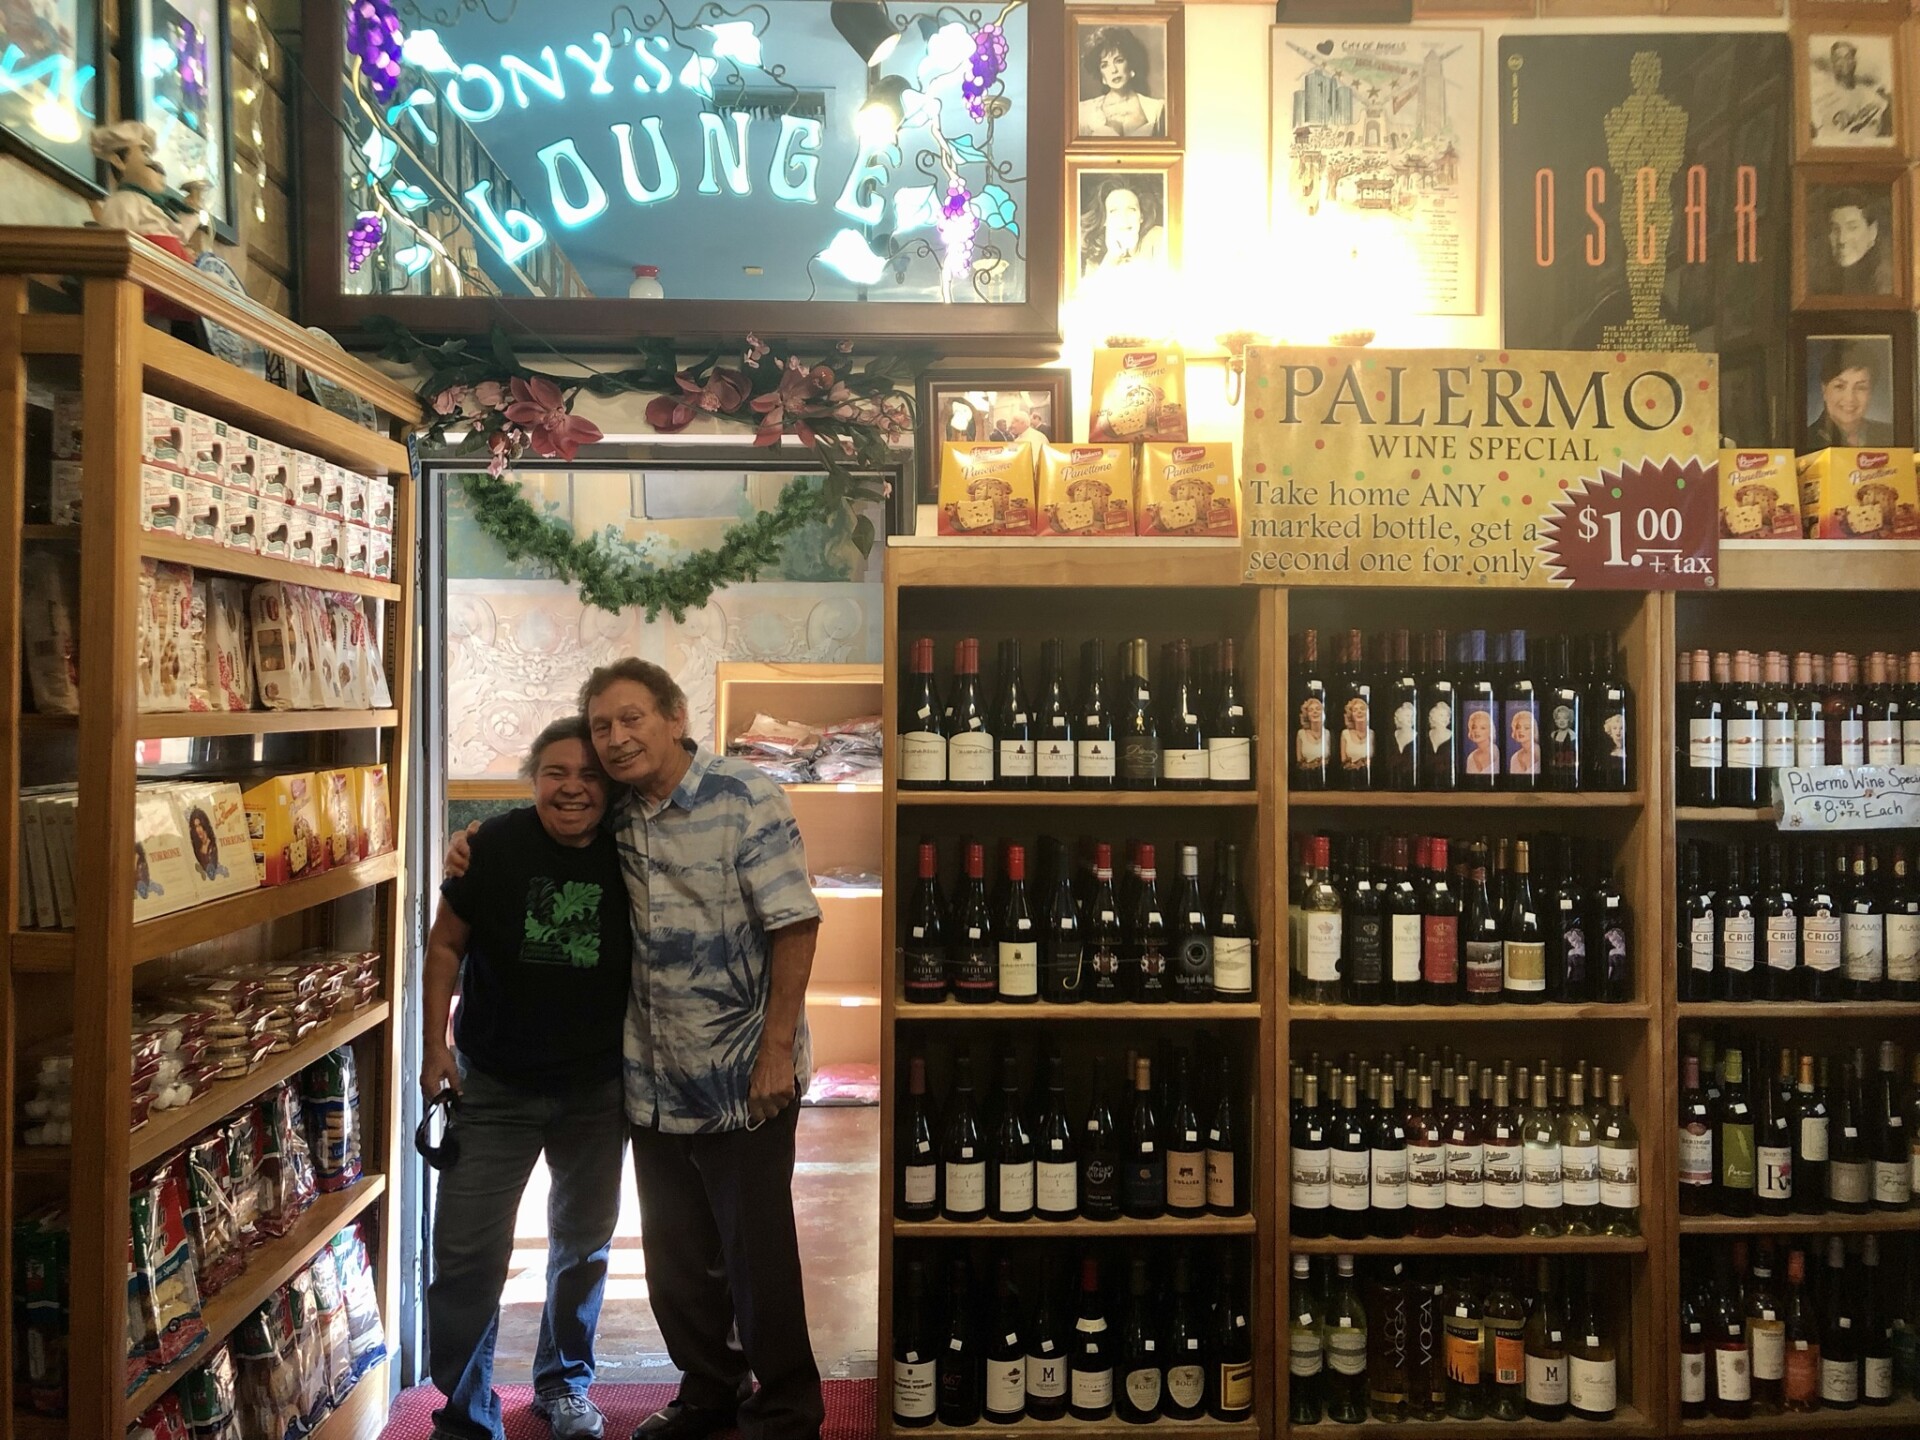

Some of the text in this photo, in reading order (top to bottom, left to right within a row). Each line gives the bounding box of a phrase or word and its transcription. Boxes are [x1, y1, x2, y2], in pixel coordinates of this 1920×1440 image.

[387, 27, 674, 147] TONY'S
[464, 110, 903, 265] LOUNGE
[1535, 164, 1759, 267] OSCAR
[1278, 364, 1686, 431] PALERMO
[1367, 434, 1600, 462] WINE SPECIAL
[1061, 463, 1113, 481] Panettone
[1163, 461, 1215, 480] Panettone
[1728, 468, 1779, 486] Panettone
[1849, 467, 1898, 486] Panettone
[1250, 479, 1487, 508] Take home ANY
[1250, 513, 1539, 548] marked bottle, get a
[1250, 549, 1537, 580] second one for only
[1673, 552, 1713, 575] tax
[1787, 771, 1849, 794] Palermo
[1849, 769, 1886, 790] Wine
[1863, 800, 1904, 819] Each
[149, 847, 182, 863] TORRONE
[1806, 932, 1840, 941] CRIOS
[1419, 1296, 1433, 1366] VOGA
[1043, 1367, 1055, 1381] M
[1546, 1366, 1559, 1381] M
